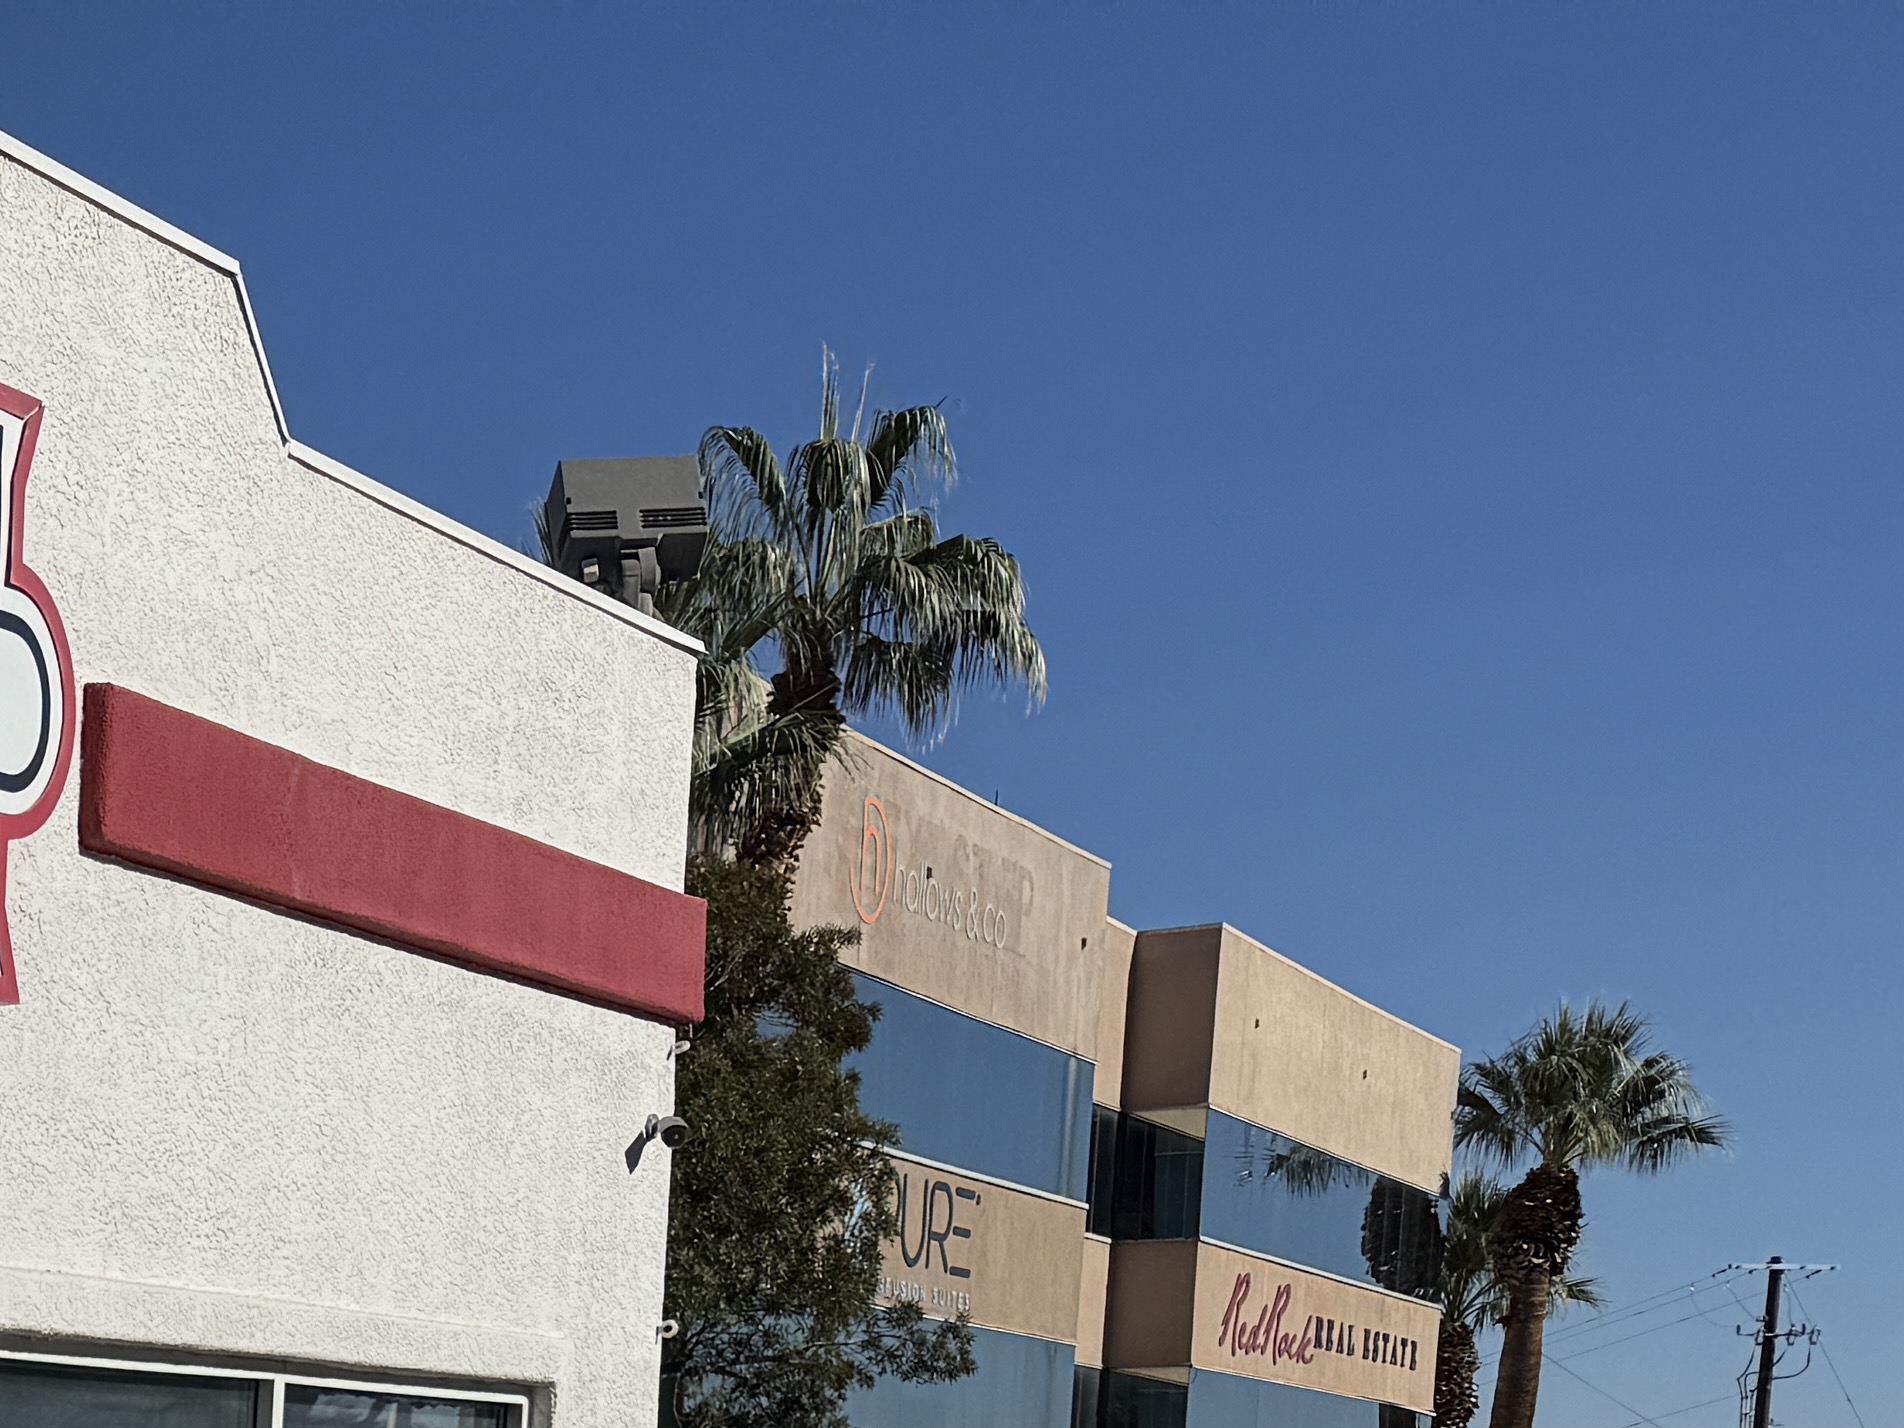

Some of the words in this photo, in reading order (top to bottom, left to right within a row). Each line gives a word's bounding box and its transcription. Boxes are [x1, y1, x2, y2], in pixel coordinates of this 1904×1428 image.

[965, 886, 980, 943] &
[983, 903, 1008, 950] co
[894, 1171, 975, 1279] URE
[1313, 1316, 1355, 1357] REAL
[1362, 1327, 1418, 1371] ESTATE
